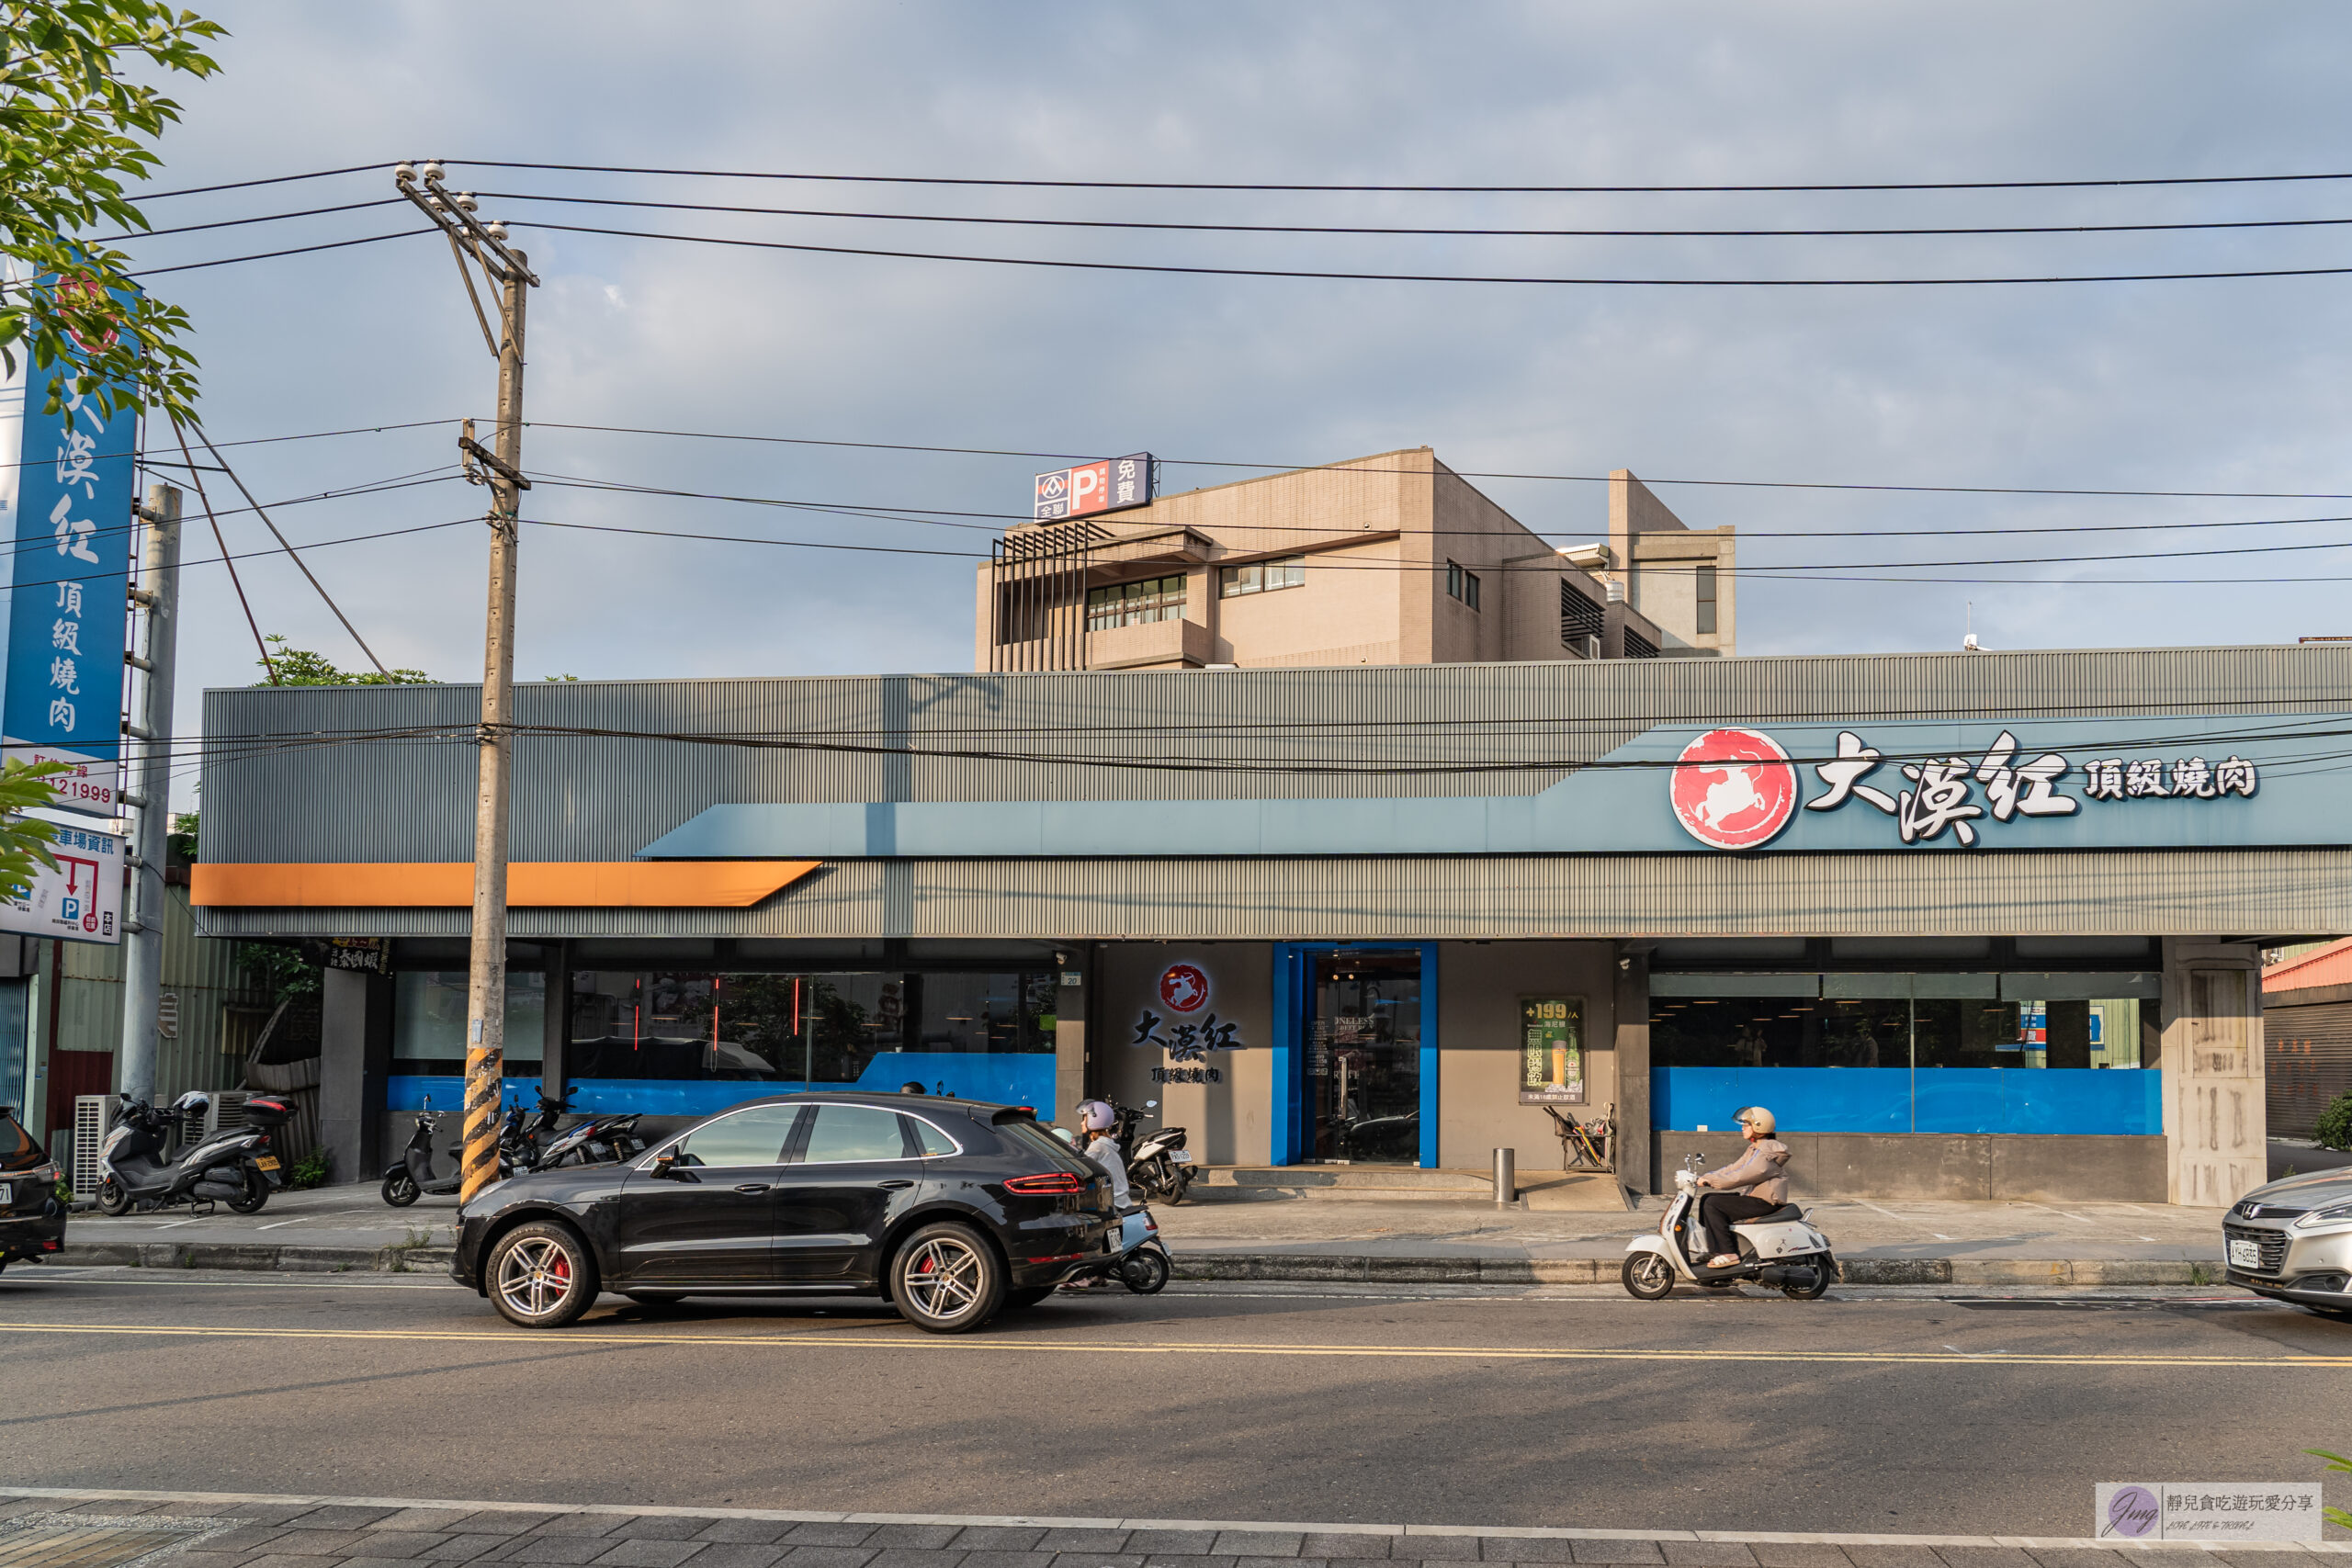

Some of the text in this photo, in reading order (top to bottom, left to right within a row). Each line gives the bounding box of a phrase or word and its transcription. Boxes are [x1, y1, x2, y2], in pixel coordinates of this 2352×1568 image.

[1072, 469, 1098, 510] P
[1117, 460, 1136, 504] 免費
[1041, 502, 1064, 518] 全聯
[49, 581, 84, 733] 頂級燒肉
[1804, 730, 2256, 847] 大漠紅 頂級燒肉
[65, 900, 77, 918] P
[104, 912, 113, 935] 本店
[1132, 1010, 1242, 1061] 大漠紅
[1151, 1066, 1220, 1084] 頂級燒肉
[1527, 1029, 1543, 1086] 無限暢飲
